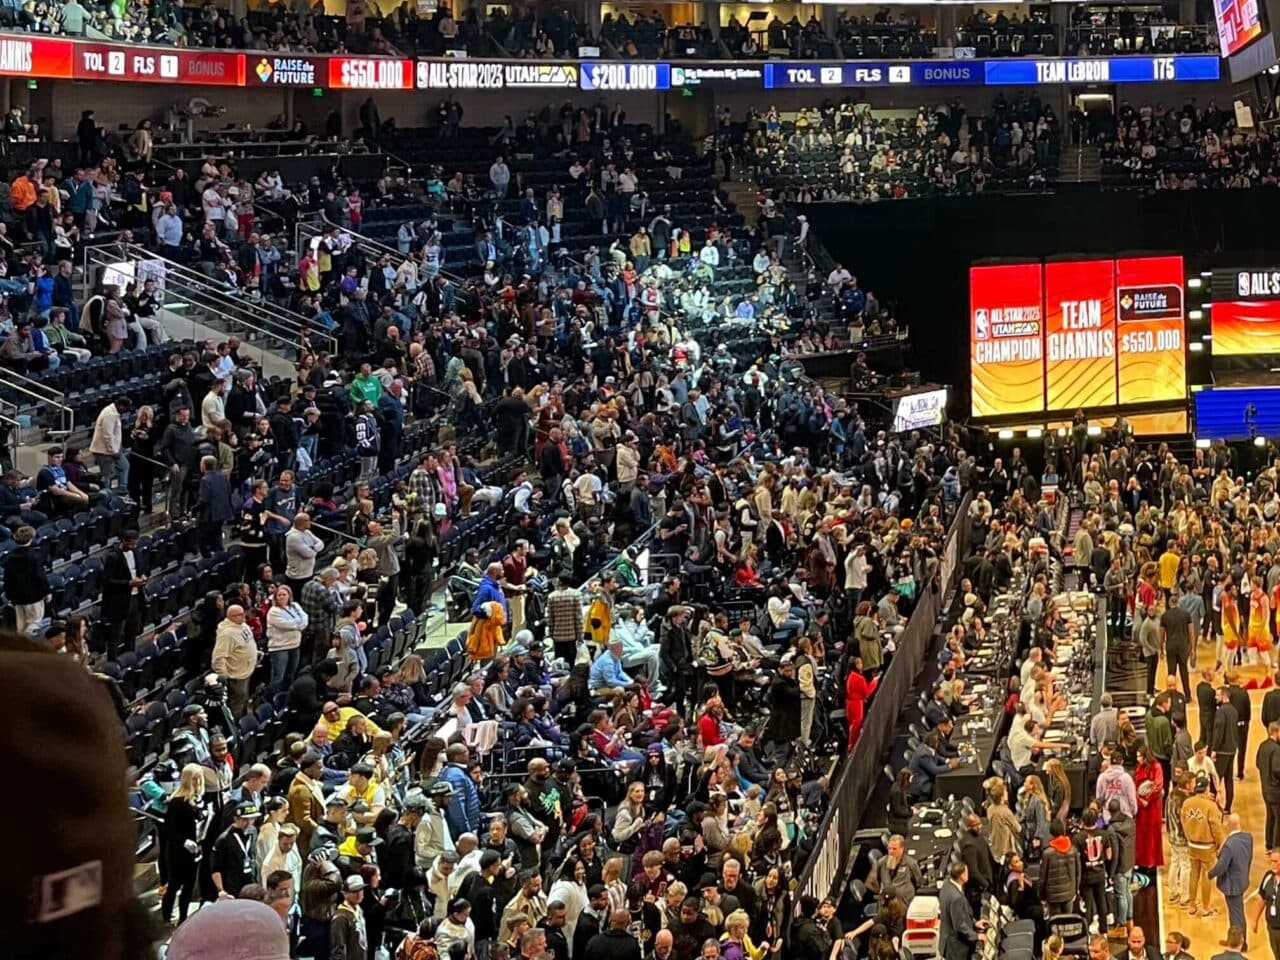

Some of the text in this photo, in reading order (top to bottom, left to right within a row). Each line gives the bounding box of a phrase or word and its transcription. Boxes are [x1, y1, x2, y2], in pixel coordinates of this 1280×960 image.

[83, 52, 224, 77] TOL 2 FLS 1 BONUS
[274, 58, 302, 71] RAISE
[478, 64, 538, 87] 2023 UTAH
[787, 68, 970, 83] TOL 2 FLS 4 BONUS
[1036, 59, 1175, 82] TEAM 175
[274, 71, 315, 84] FUTURE
[1060, 299, 1101, 329] TEAM
[976, 339, 1041, 364] CHAMPION
[1050, 331, 1113, 361] GIANNIS
[1122, 329, 1180, 353] $550,000
